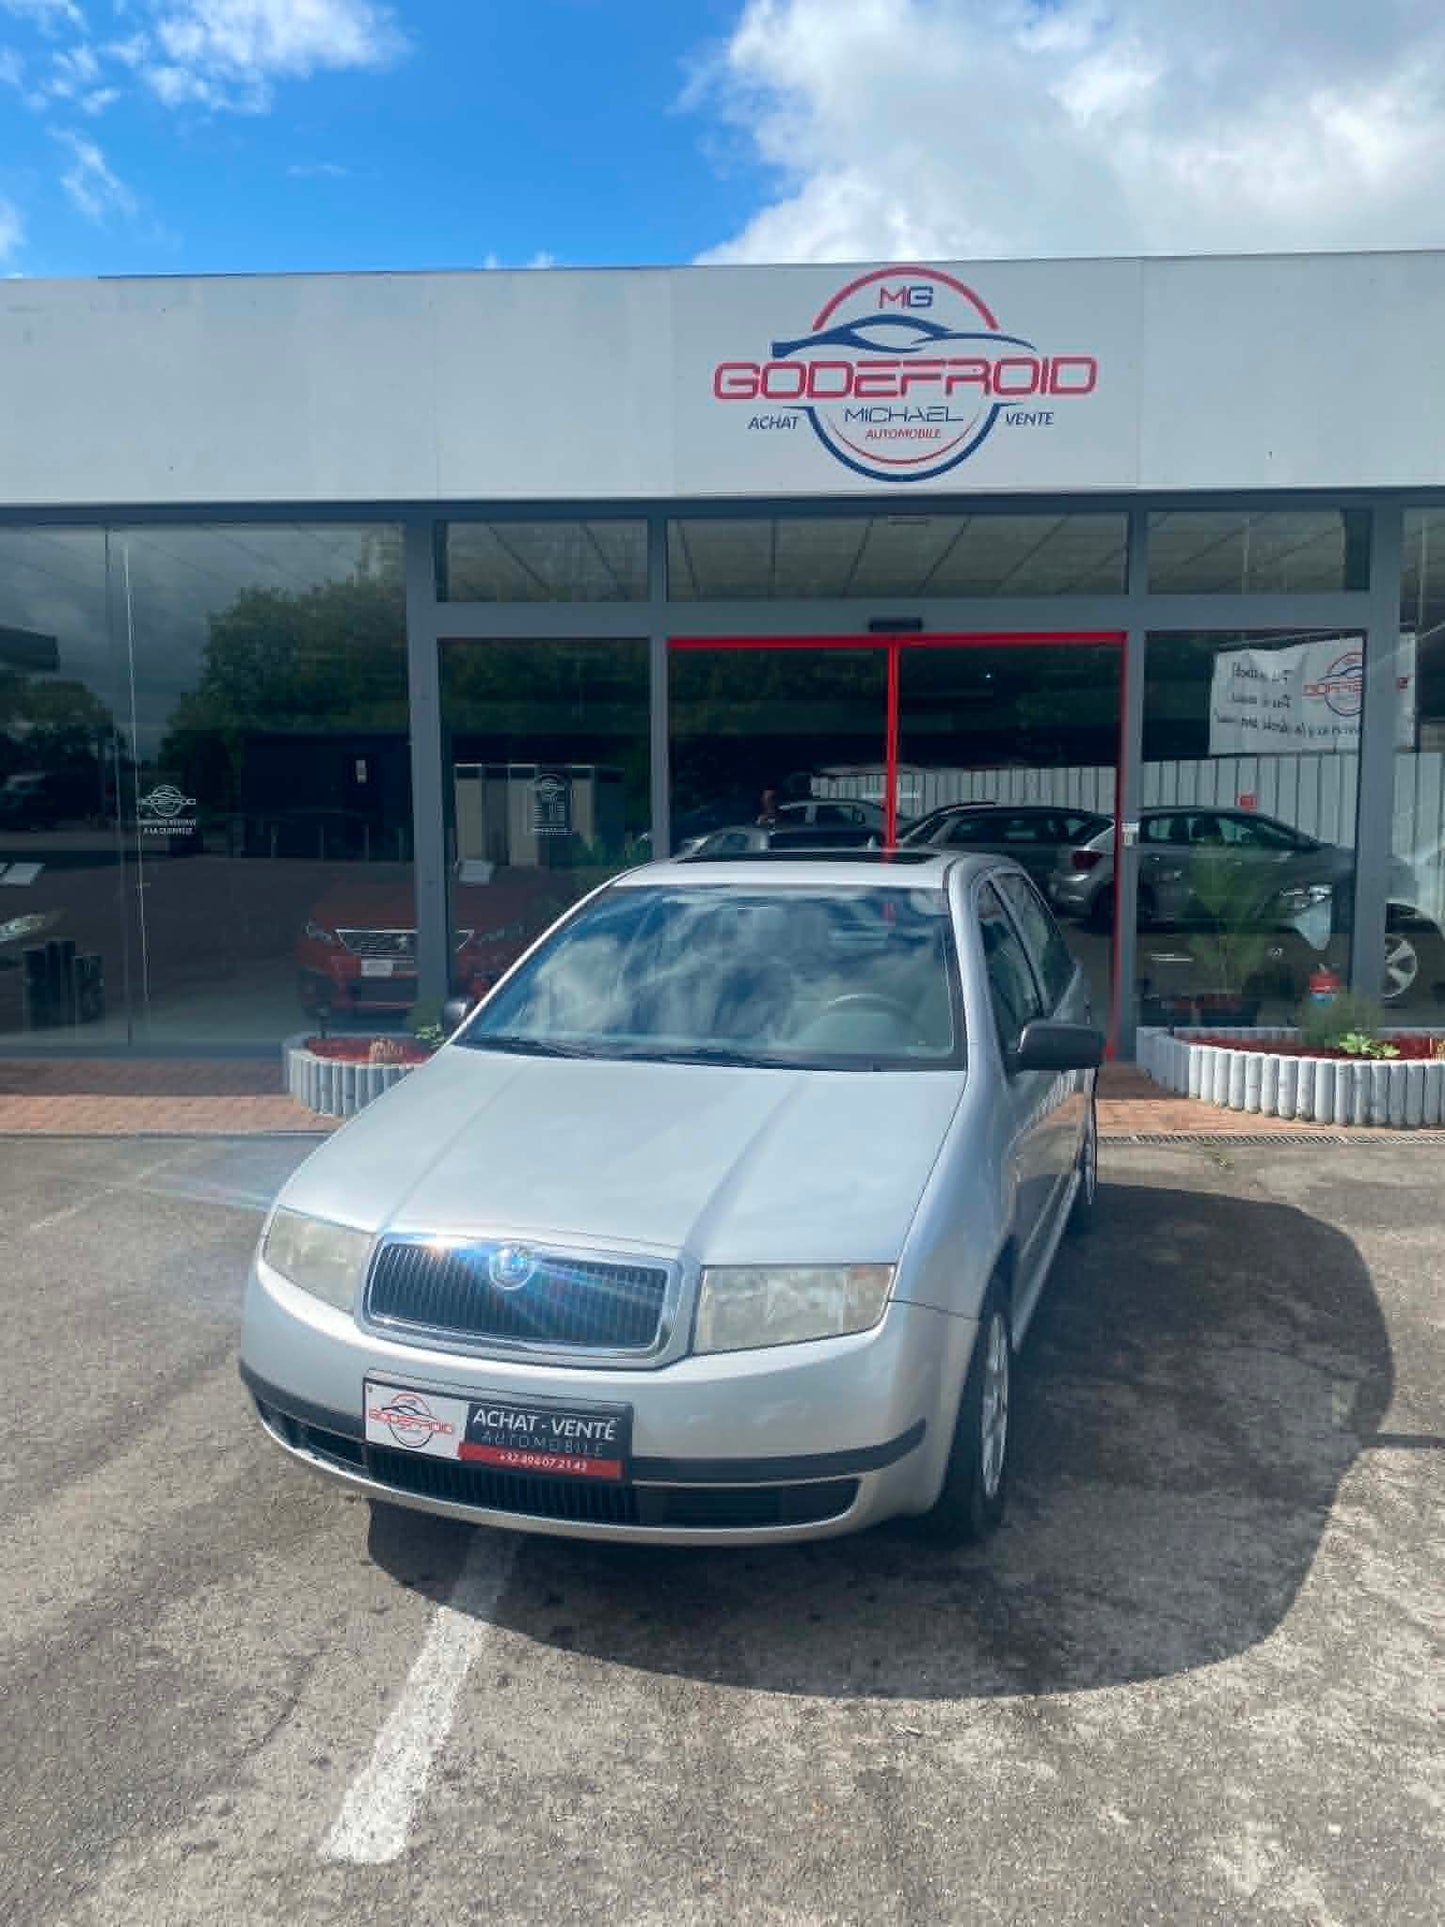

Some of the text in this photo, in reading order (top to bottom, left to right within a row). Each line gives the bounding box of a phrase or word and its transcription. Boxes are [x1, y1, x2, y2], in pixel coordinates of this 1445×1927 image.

[879, 286, 933, 308] MG
[713, 356, 1099, 399] GODEFROID
[747, 413, 799, 430] ACHAT
[843, 405, 965, 423] MICHAEL
[1005, 411, 1056, 427] VENTE
[865, 428, 942, 441] AUTOMOBILE
[472, 1408, 539, 1431] ACHAT
[481, 1430, 606, 1456] AUTOMOBILE
